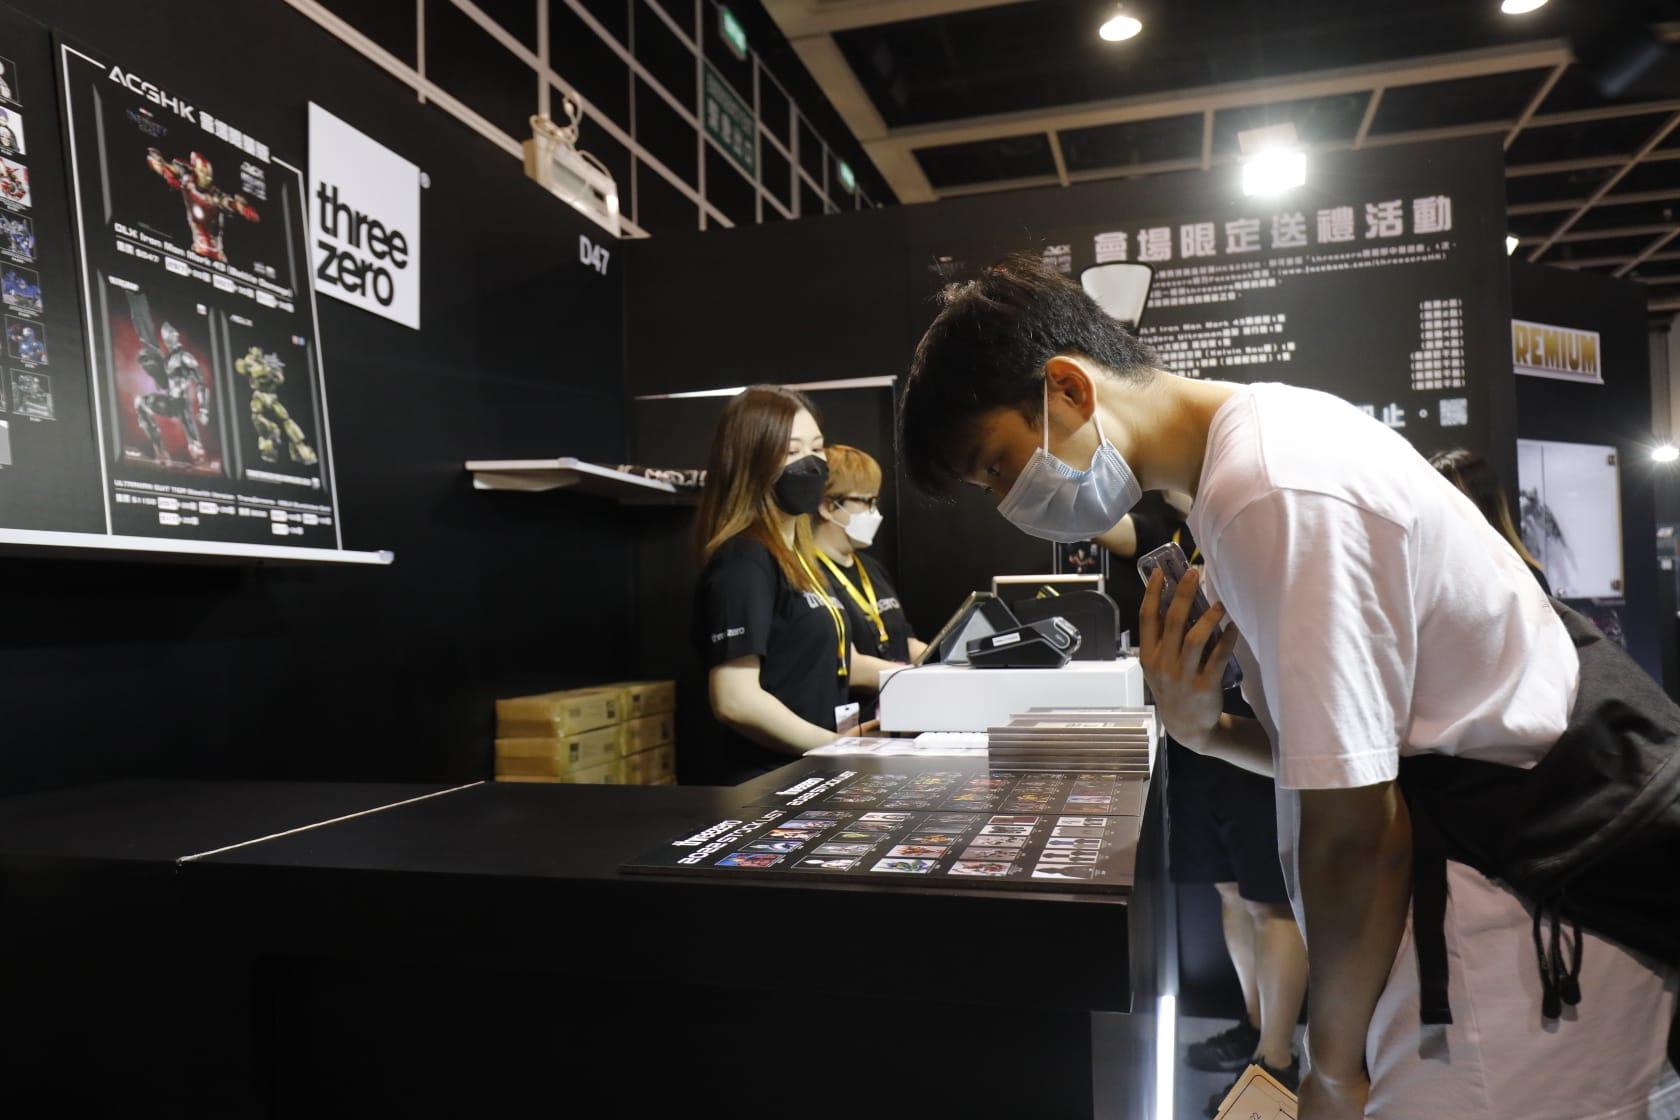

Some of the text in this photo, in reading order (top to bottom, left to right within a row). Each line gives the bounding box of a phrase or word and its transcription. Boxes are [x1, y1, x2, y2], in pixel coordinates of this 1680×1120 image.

[316, 180, 409, 270] three
[579, 235, 610, 276] D47
[1093, 194, 1453, 264] 會場限定送禮活動
[317, 239, 394, 306] zero
[676, 843, 728, 865] 2022
[716, 821, 768, 843] STOCK
